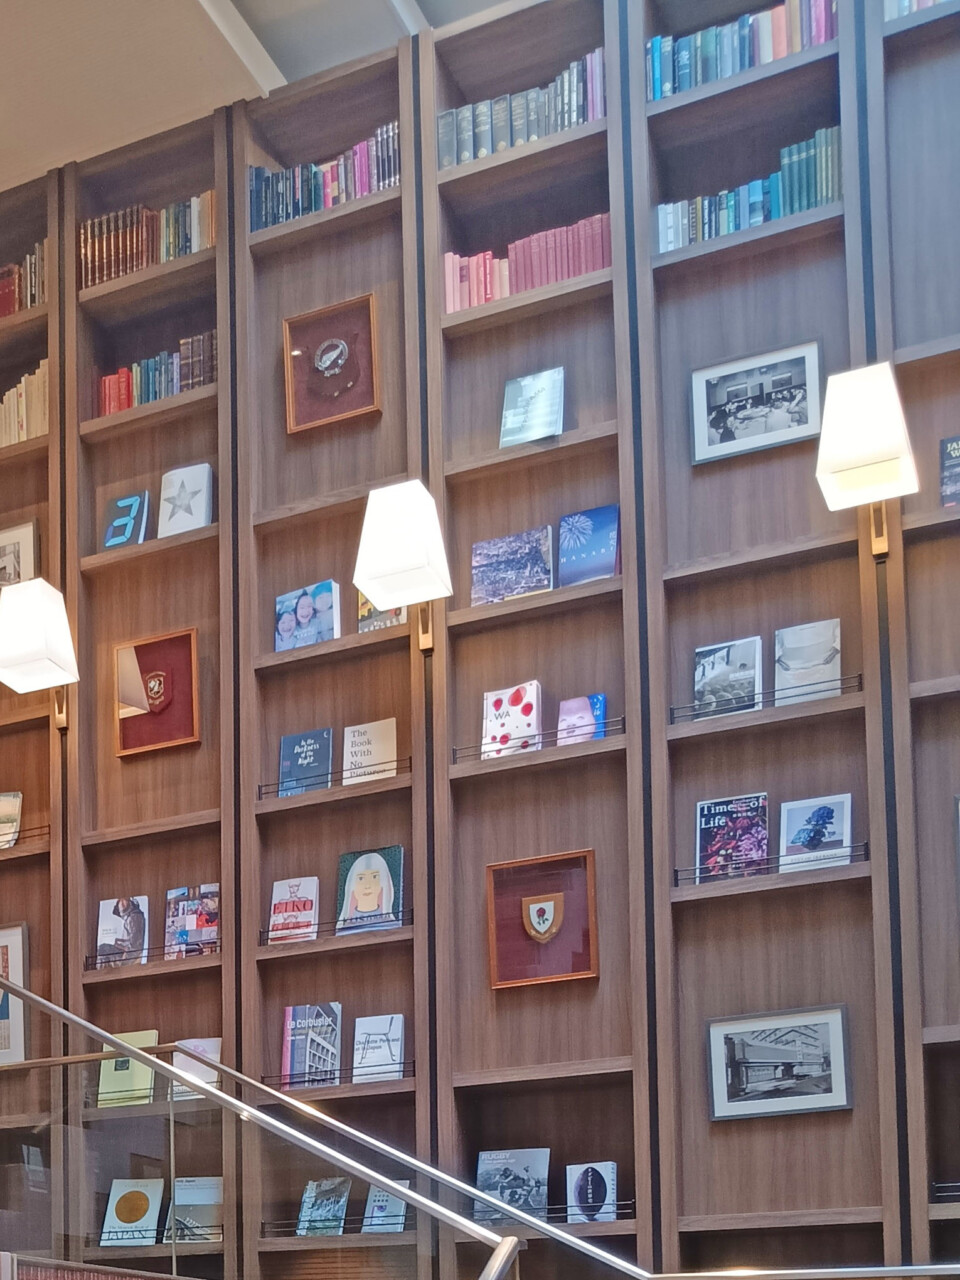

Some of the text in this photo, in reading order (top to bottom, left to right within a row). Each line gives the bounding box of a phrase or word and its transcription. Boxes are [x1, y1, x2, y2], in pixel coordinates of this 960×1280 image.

[494, 711, 511, 720] WA
[351, 730, 368, 738] The
[350, 738, 372, 748] Book
[294, 744, 320, 754] Darkness
[350, 749, 372, 758] With
[298, 756, 315, 767] Night
[700, 801, 735, 814] Time
[750, 796, 765, 808] of
[700, 816, 726, 828] Life
[296, 1017, 333, 1028] Corbusier
[481, 1152, 511, 1160] RUGBY
